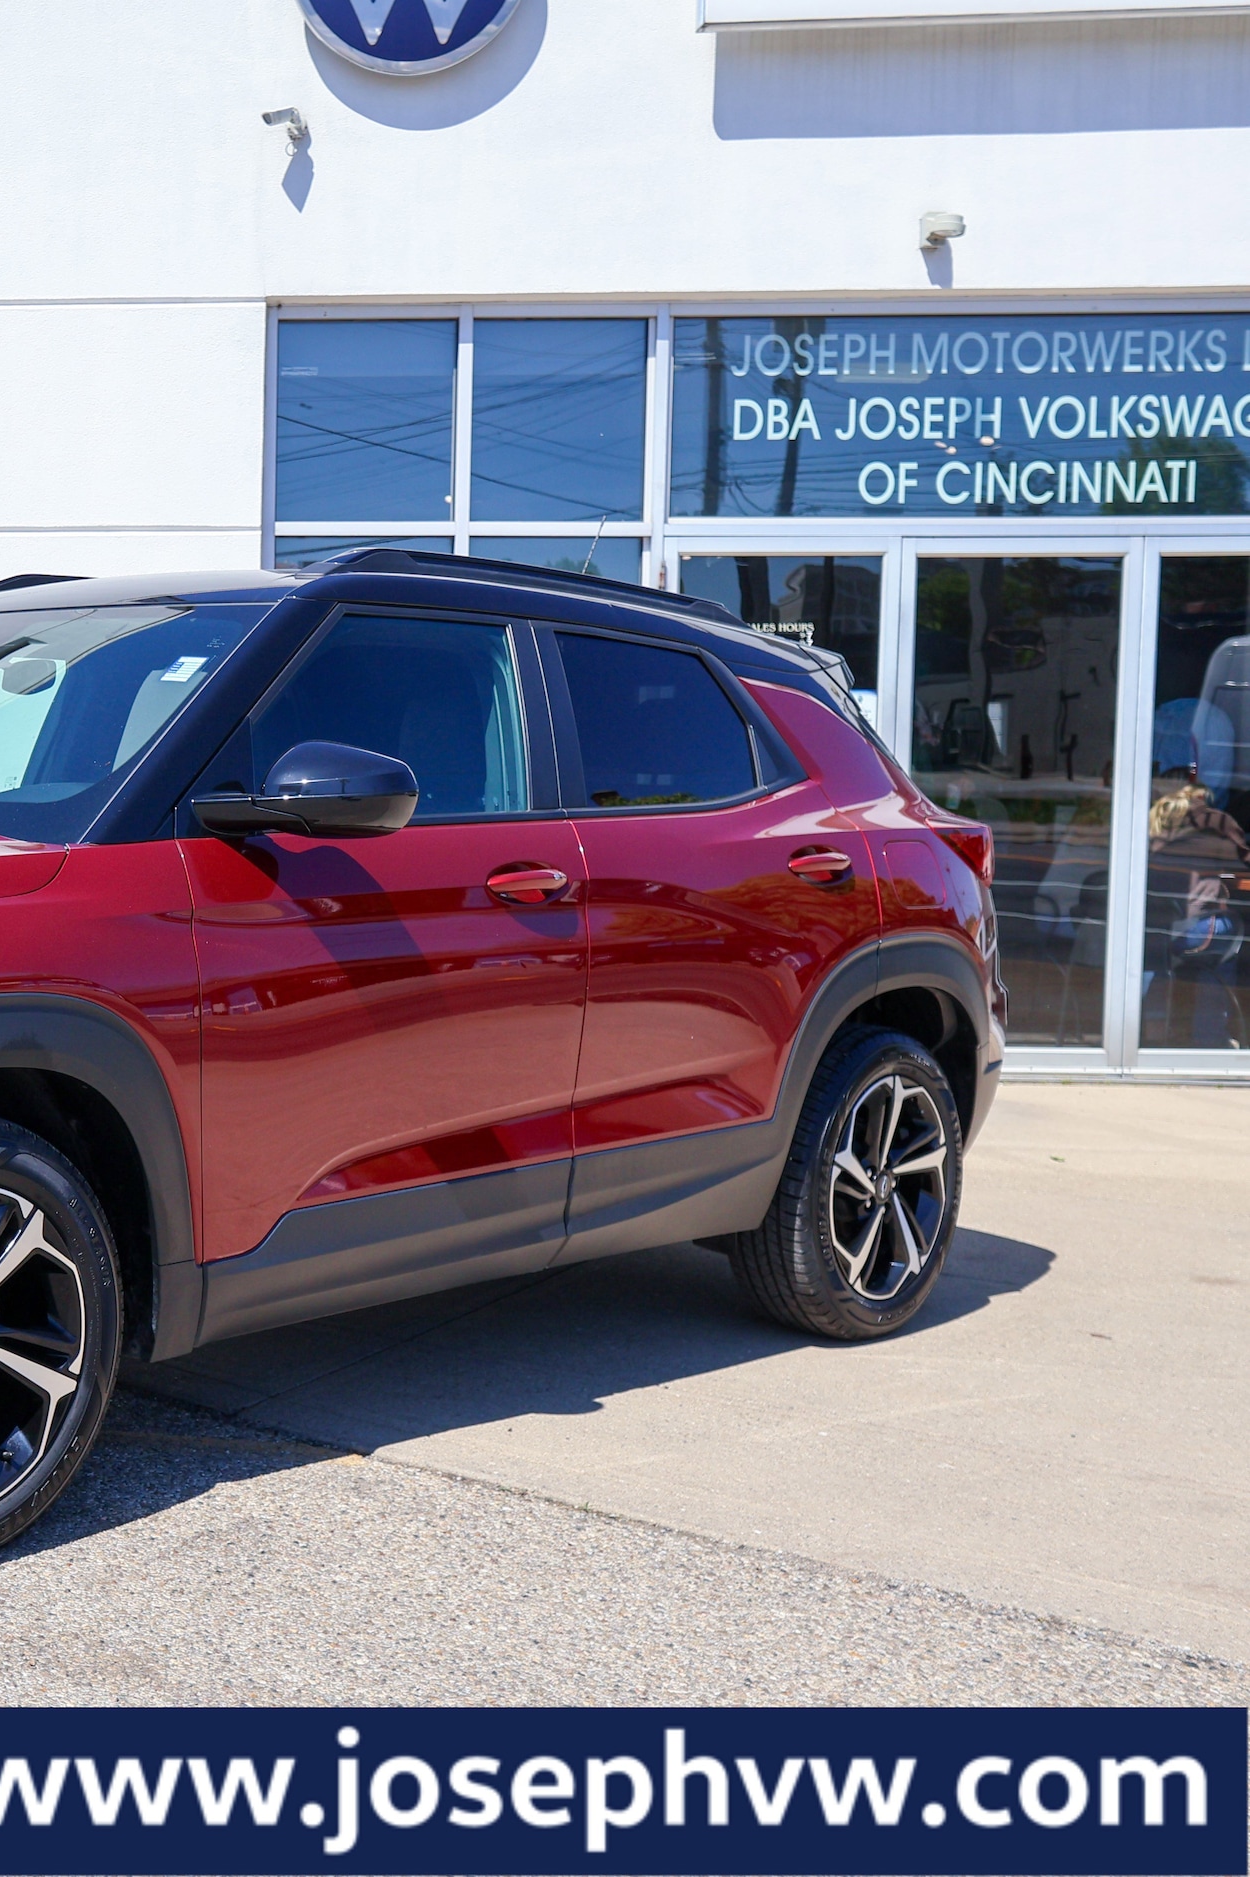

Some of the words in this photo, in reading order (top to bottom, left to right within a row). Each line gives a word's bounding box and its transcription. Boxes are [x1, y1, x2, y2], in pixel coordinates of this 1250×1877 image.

[730, 333, 896, 377] JOSEPH
[910, 329, 1227, 375] MOTORWERKS
[733, 398, 822, 441] DBA
[834, 396, 1002, 441] JOSEPH
[858, 461, 919, 505] OF
[935, 460, 1197, 505] CINCINNATI
[778, 621, 815, 633] HOURS
